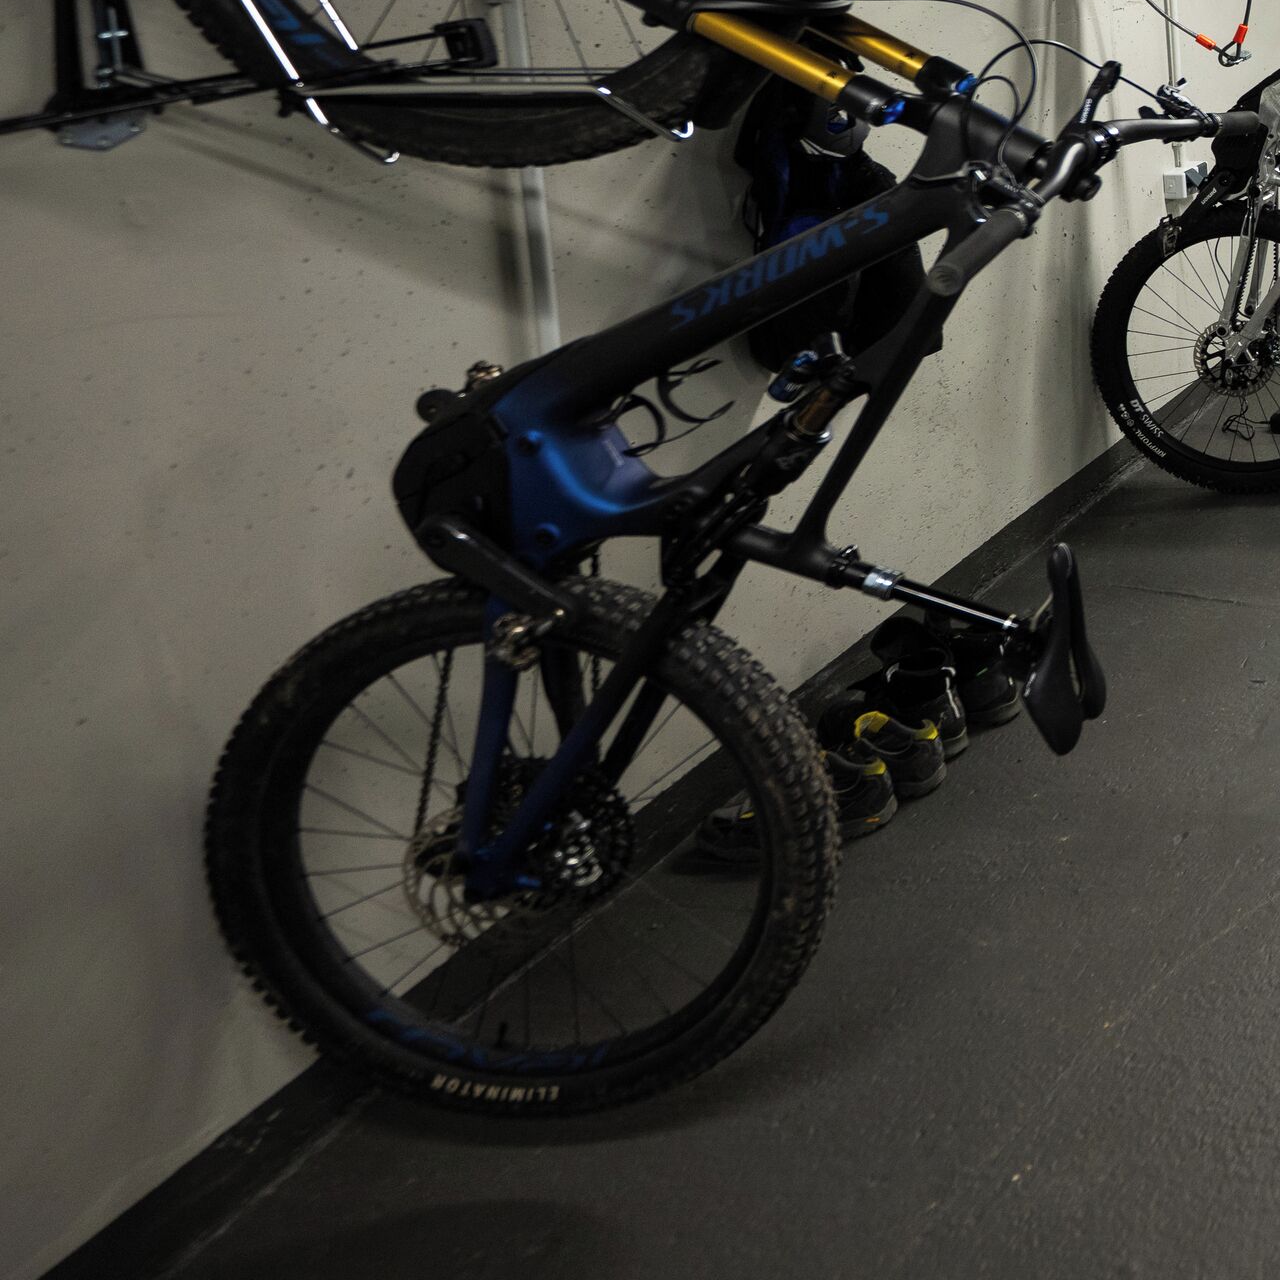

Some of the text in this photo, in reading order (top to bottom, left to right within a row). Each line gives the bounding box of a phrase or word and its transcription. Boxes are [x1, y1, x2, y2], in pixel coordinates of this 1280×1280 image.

[671, 205, 890, 332] S-WORKS
[1130, 398, 1164, 438] DT SWISS
[1135, 429, 1167, 458] KRYPTOTAL
[430, 1073, 560, 1102] ELIMINATOR
